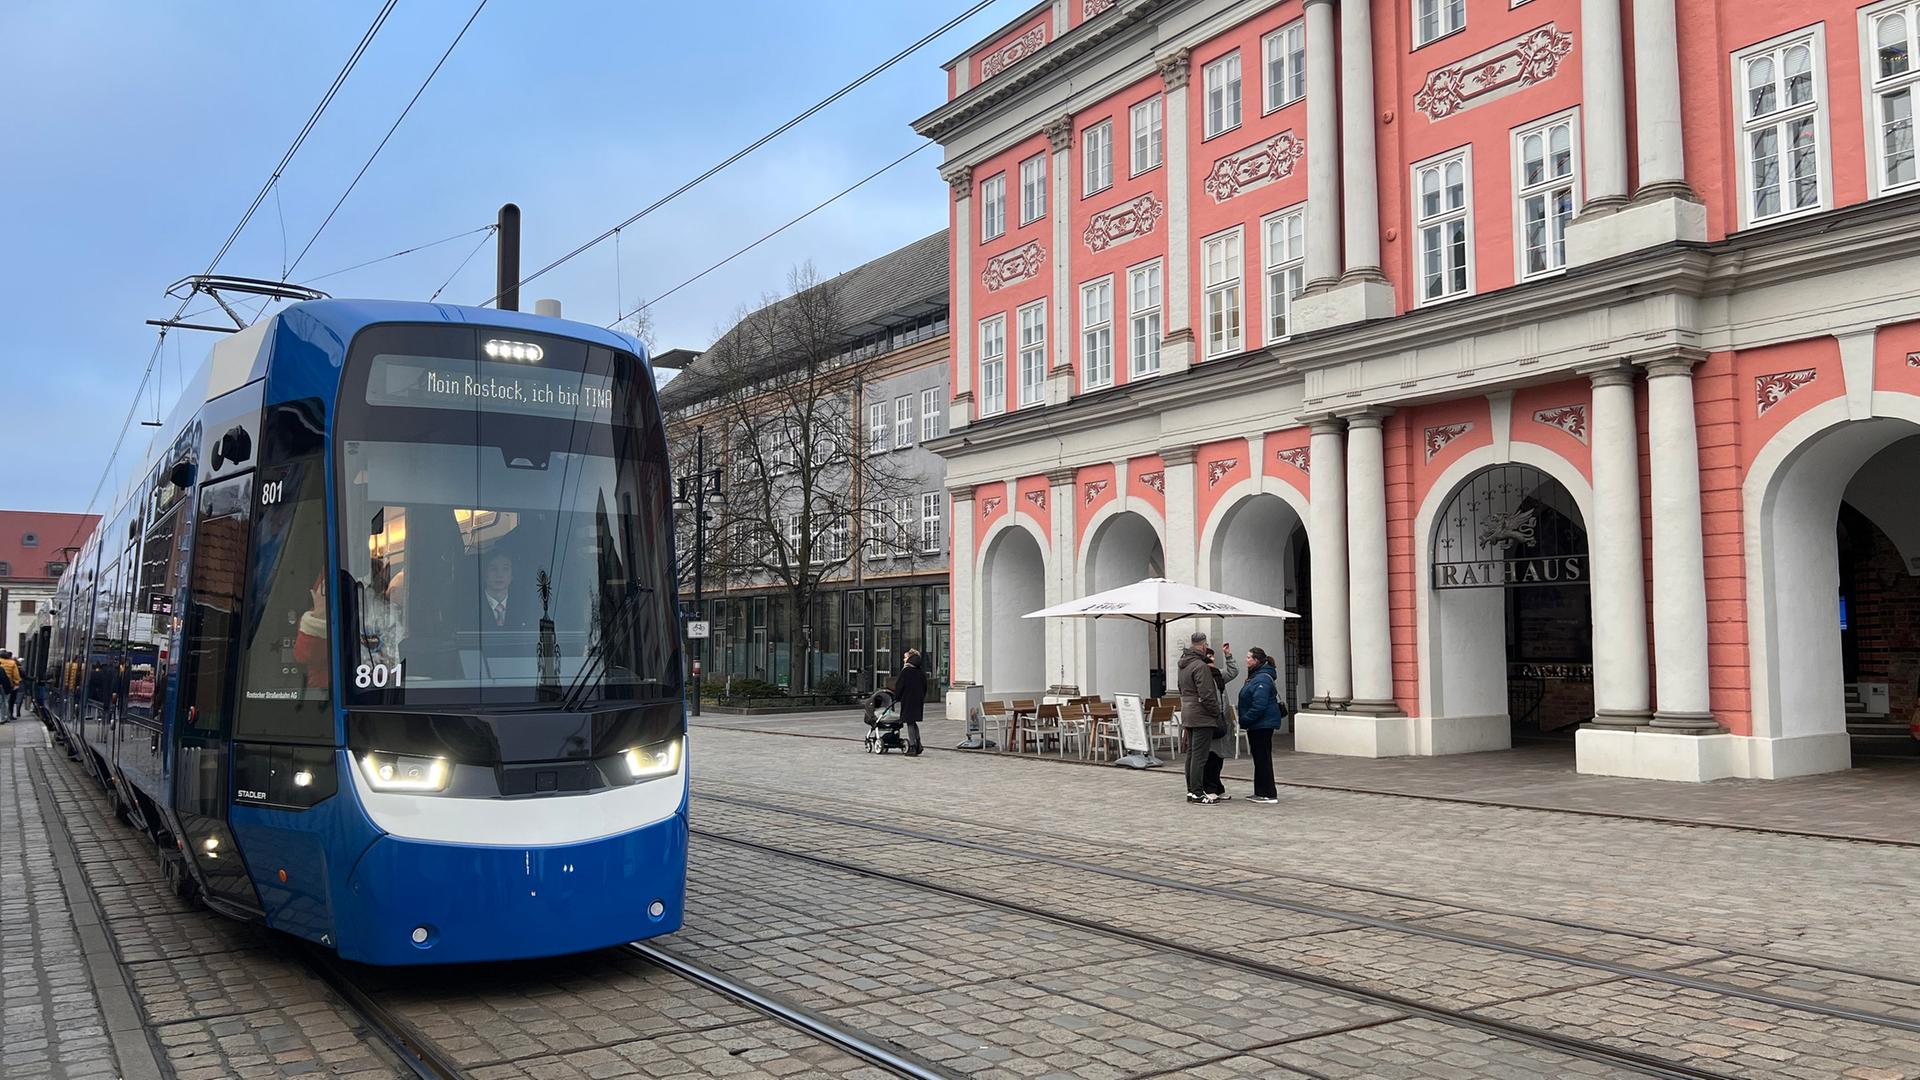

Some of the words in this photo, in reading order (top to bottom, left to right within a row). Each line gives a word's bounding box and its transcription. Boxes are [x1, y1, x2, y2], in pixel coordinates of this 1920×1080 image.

[428, 371, 460, 394] Moin
[464, 375, 528, 403] Rostock,
[532, 383, 554, 403] ich
[558, 385, 581, 406] bin
[585, 387, 612, 409] TINA
[262, 480, 283, 505] 801
[1441, 558, 1581, 586] RATHAUS
[355, 663, 402, 688] 801
[290, 691, 298, 700] AG
[237, 789, 267, 800] STADLER
